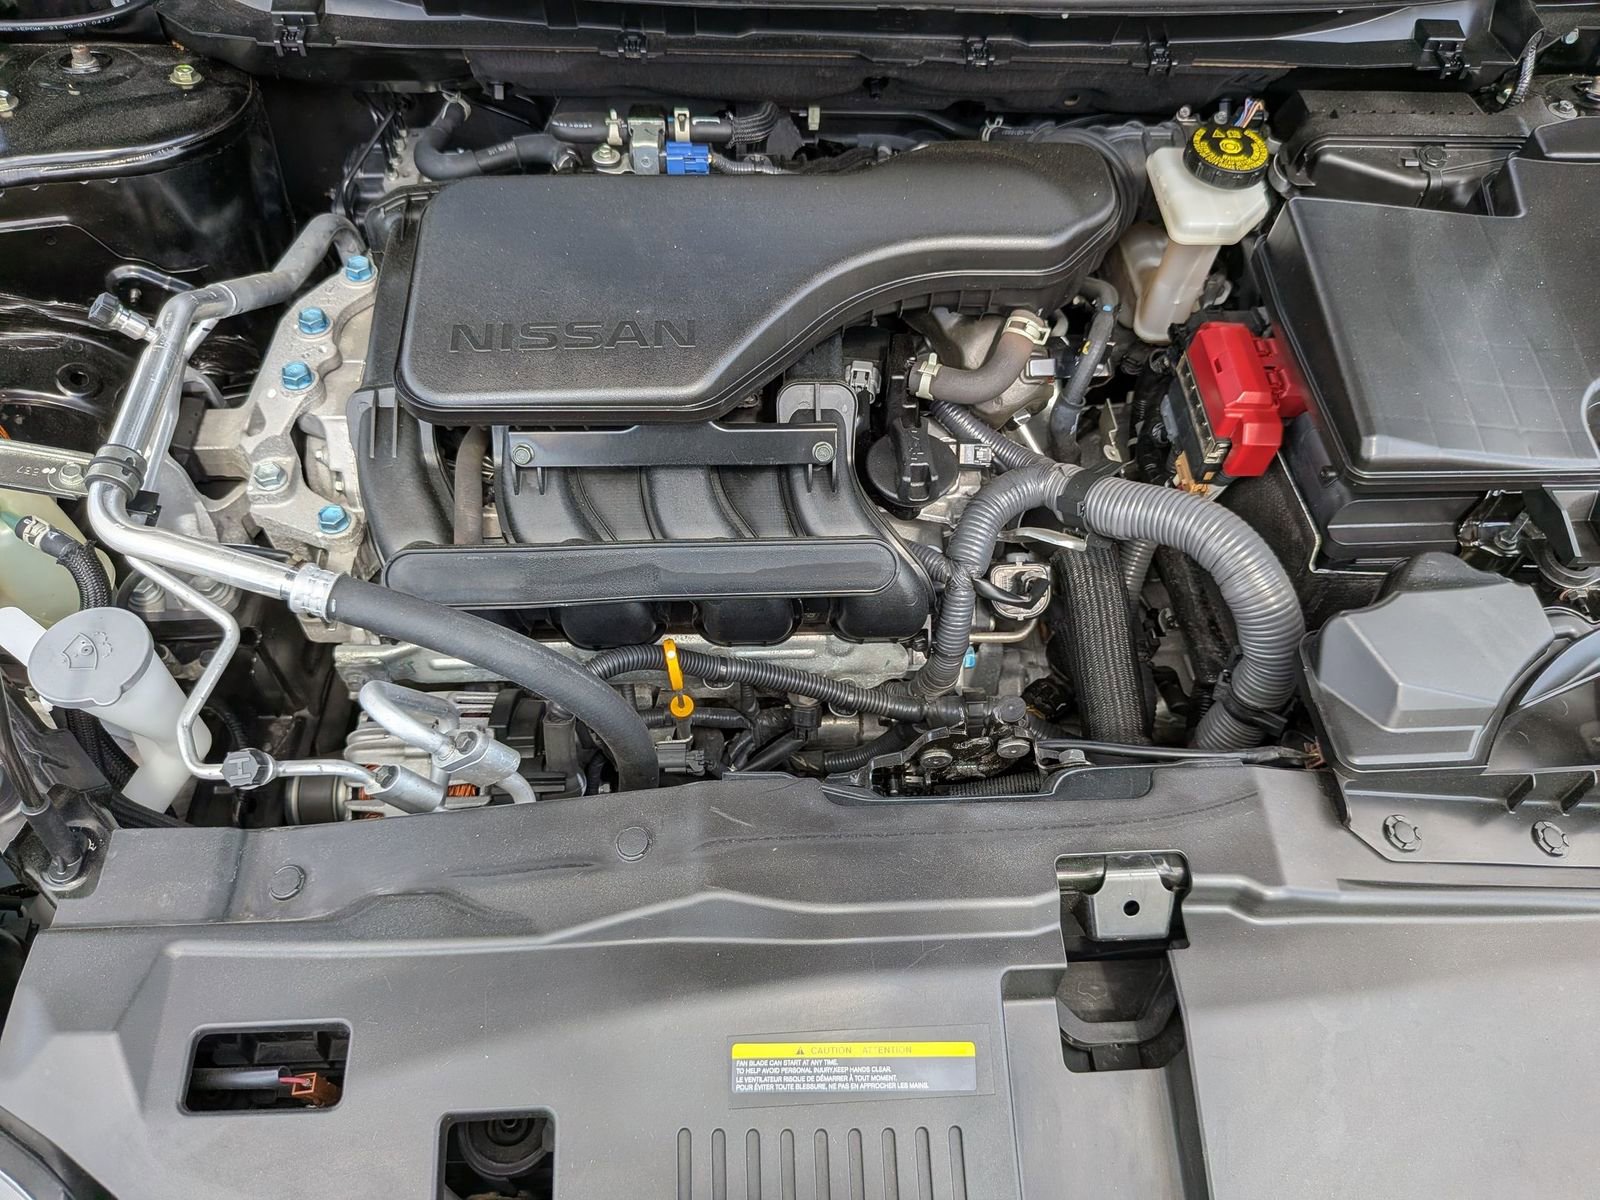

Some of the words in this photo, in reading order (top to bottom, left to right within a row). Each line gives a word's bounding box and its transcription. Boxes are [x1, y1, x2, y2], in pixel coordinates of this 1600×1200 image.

[450, 319, 696, 352] NISSAN
[810, 1046, 852, 1055] CAUTION
[862, 1045, 912, 1055] ATTENTION
[824, 1058, 839, 1066] TIME.
[736, 1067, 744, 1075] TO
[744, 1075, 782, 1083] VENTILATEUR
[783, 1075, 805, 1083] RISQUE
